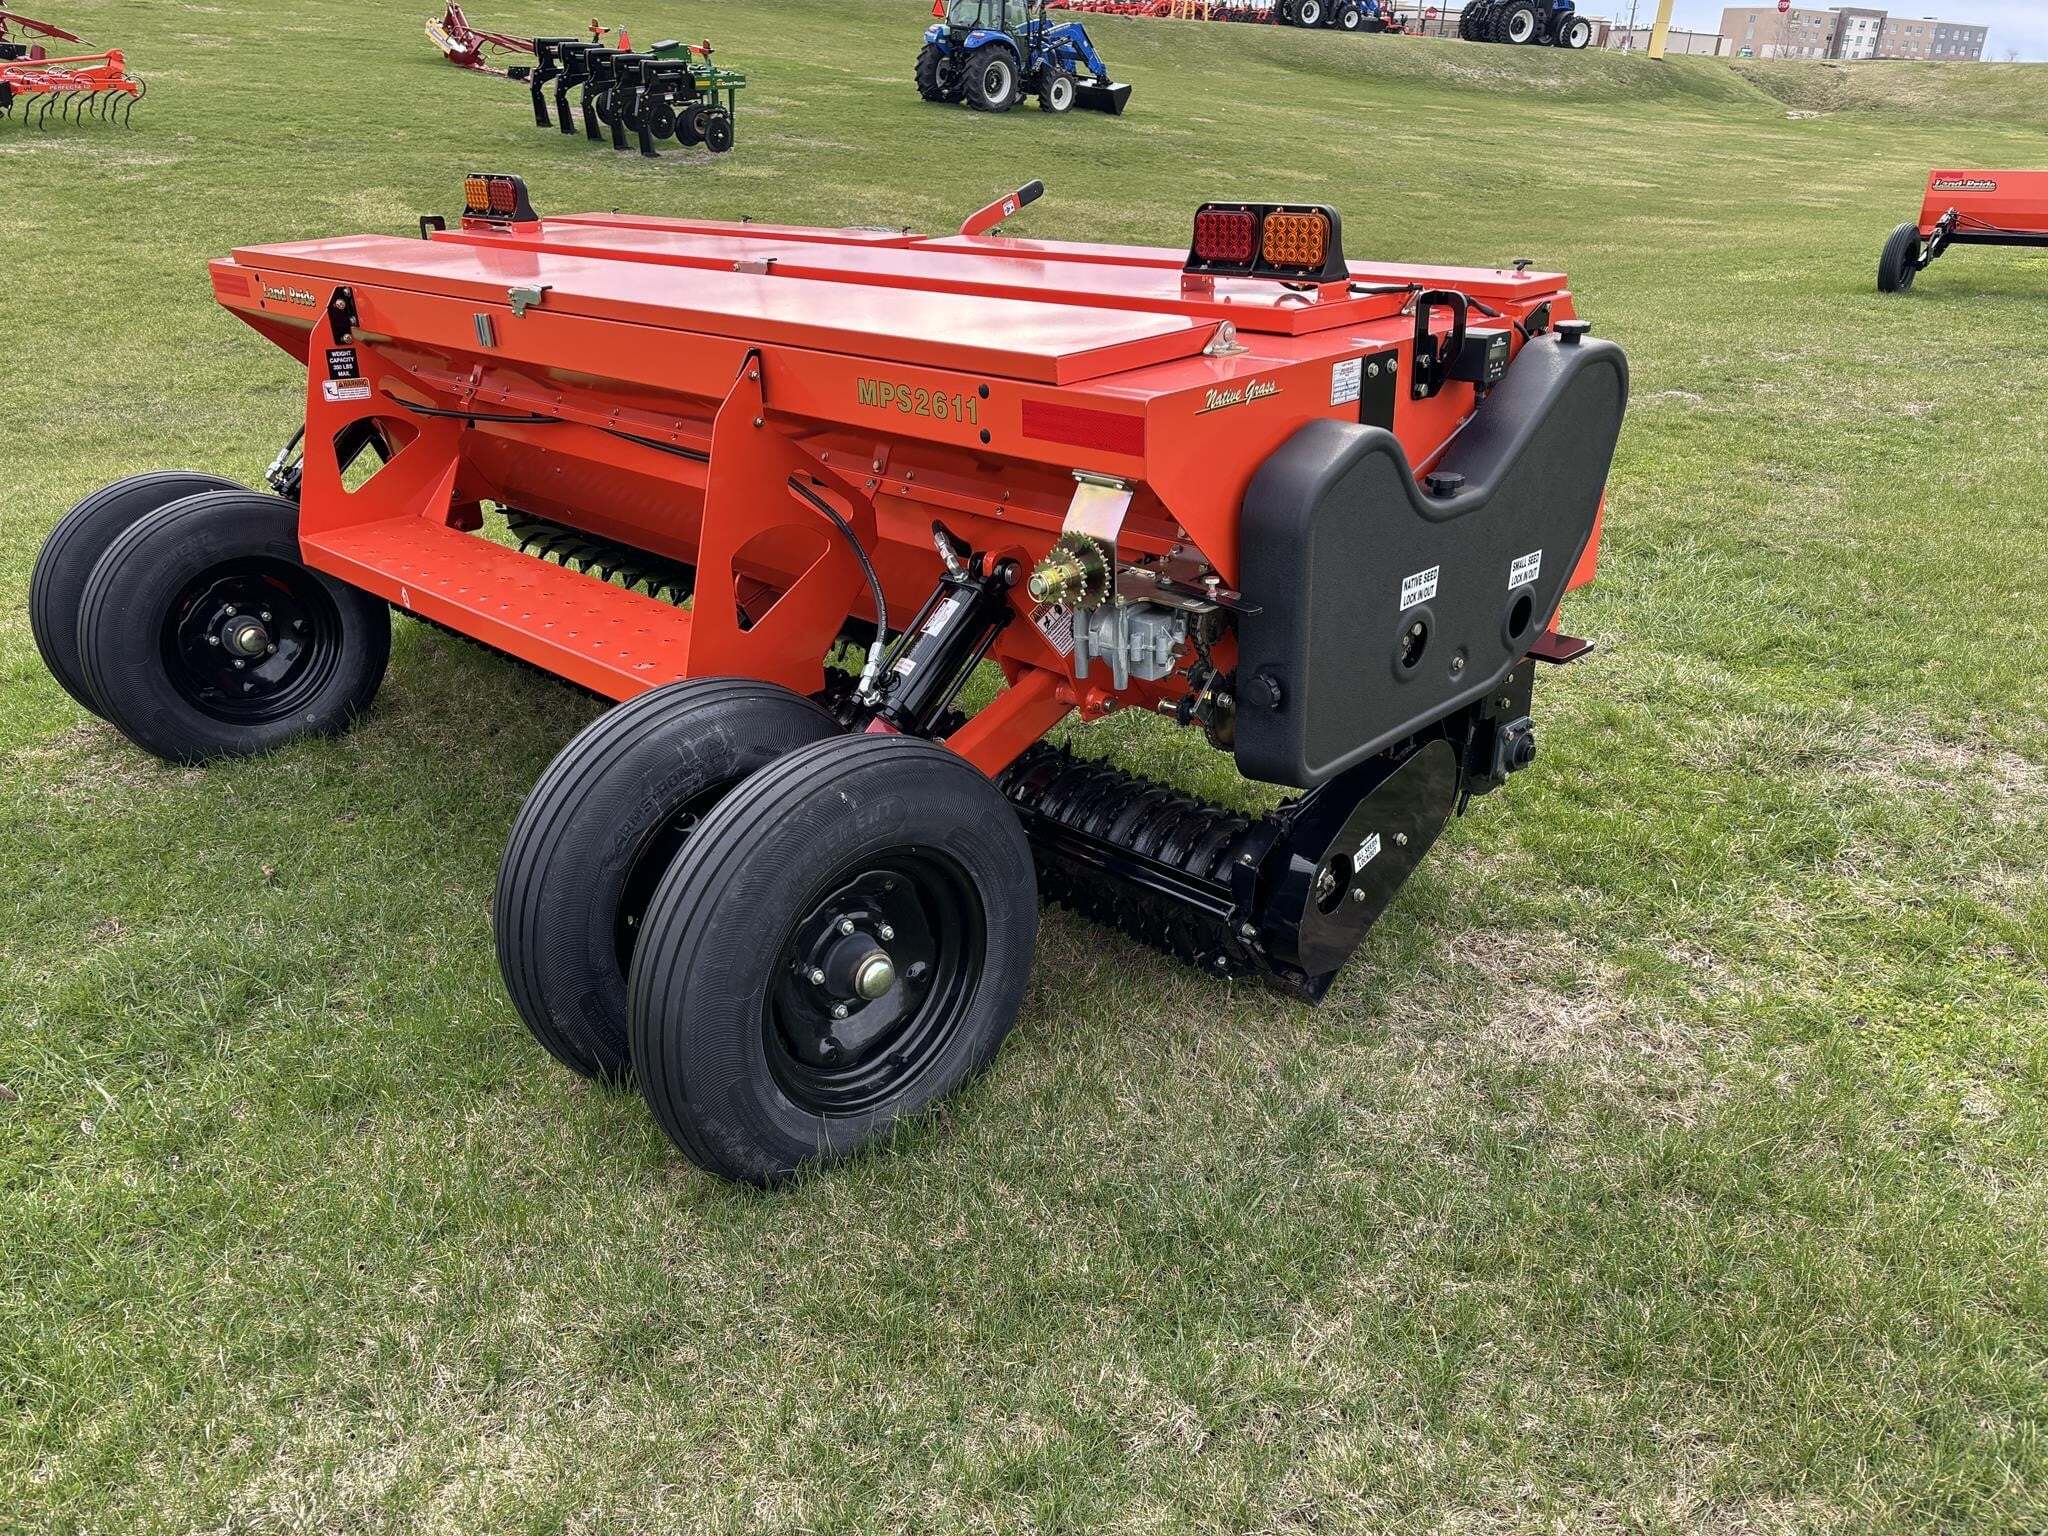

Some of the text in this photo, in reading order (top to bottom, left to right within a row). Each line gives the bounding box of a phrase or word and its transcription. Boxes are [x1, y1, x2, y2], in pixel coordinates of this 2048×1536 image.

[1932, 179, 1996, 190] Land Pride
[262, 281, 316, 306] Land Pride
[343, 379, 368, 388] WARNING
[857, 377, 978, 425] MPS2611
[1205, 379, 1277, 409] Native Grass
[1512, 552, 1540, 572] SMALL SEED
[1403, 568, 1438, 592] NATIVE SEED
[1511, 570, 1523, 586] LOCK
[1403, 591, 1417, 607] LOCK
